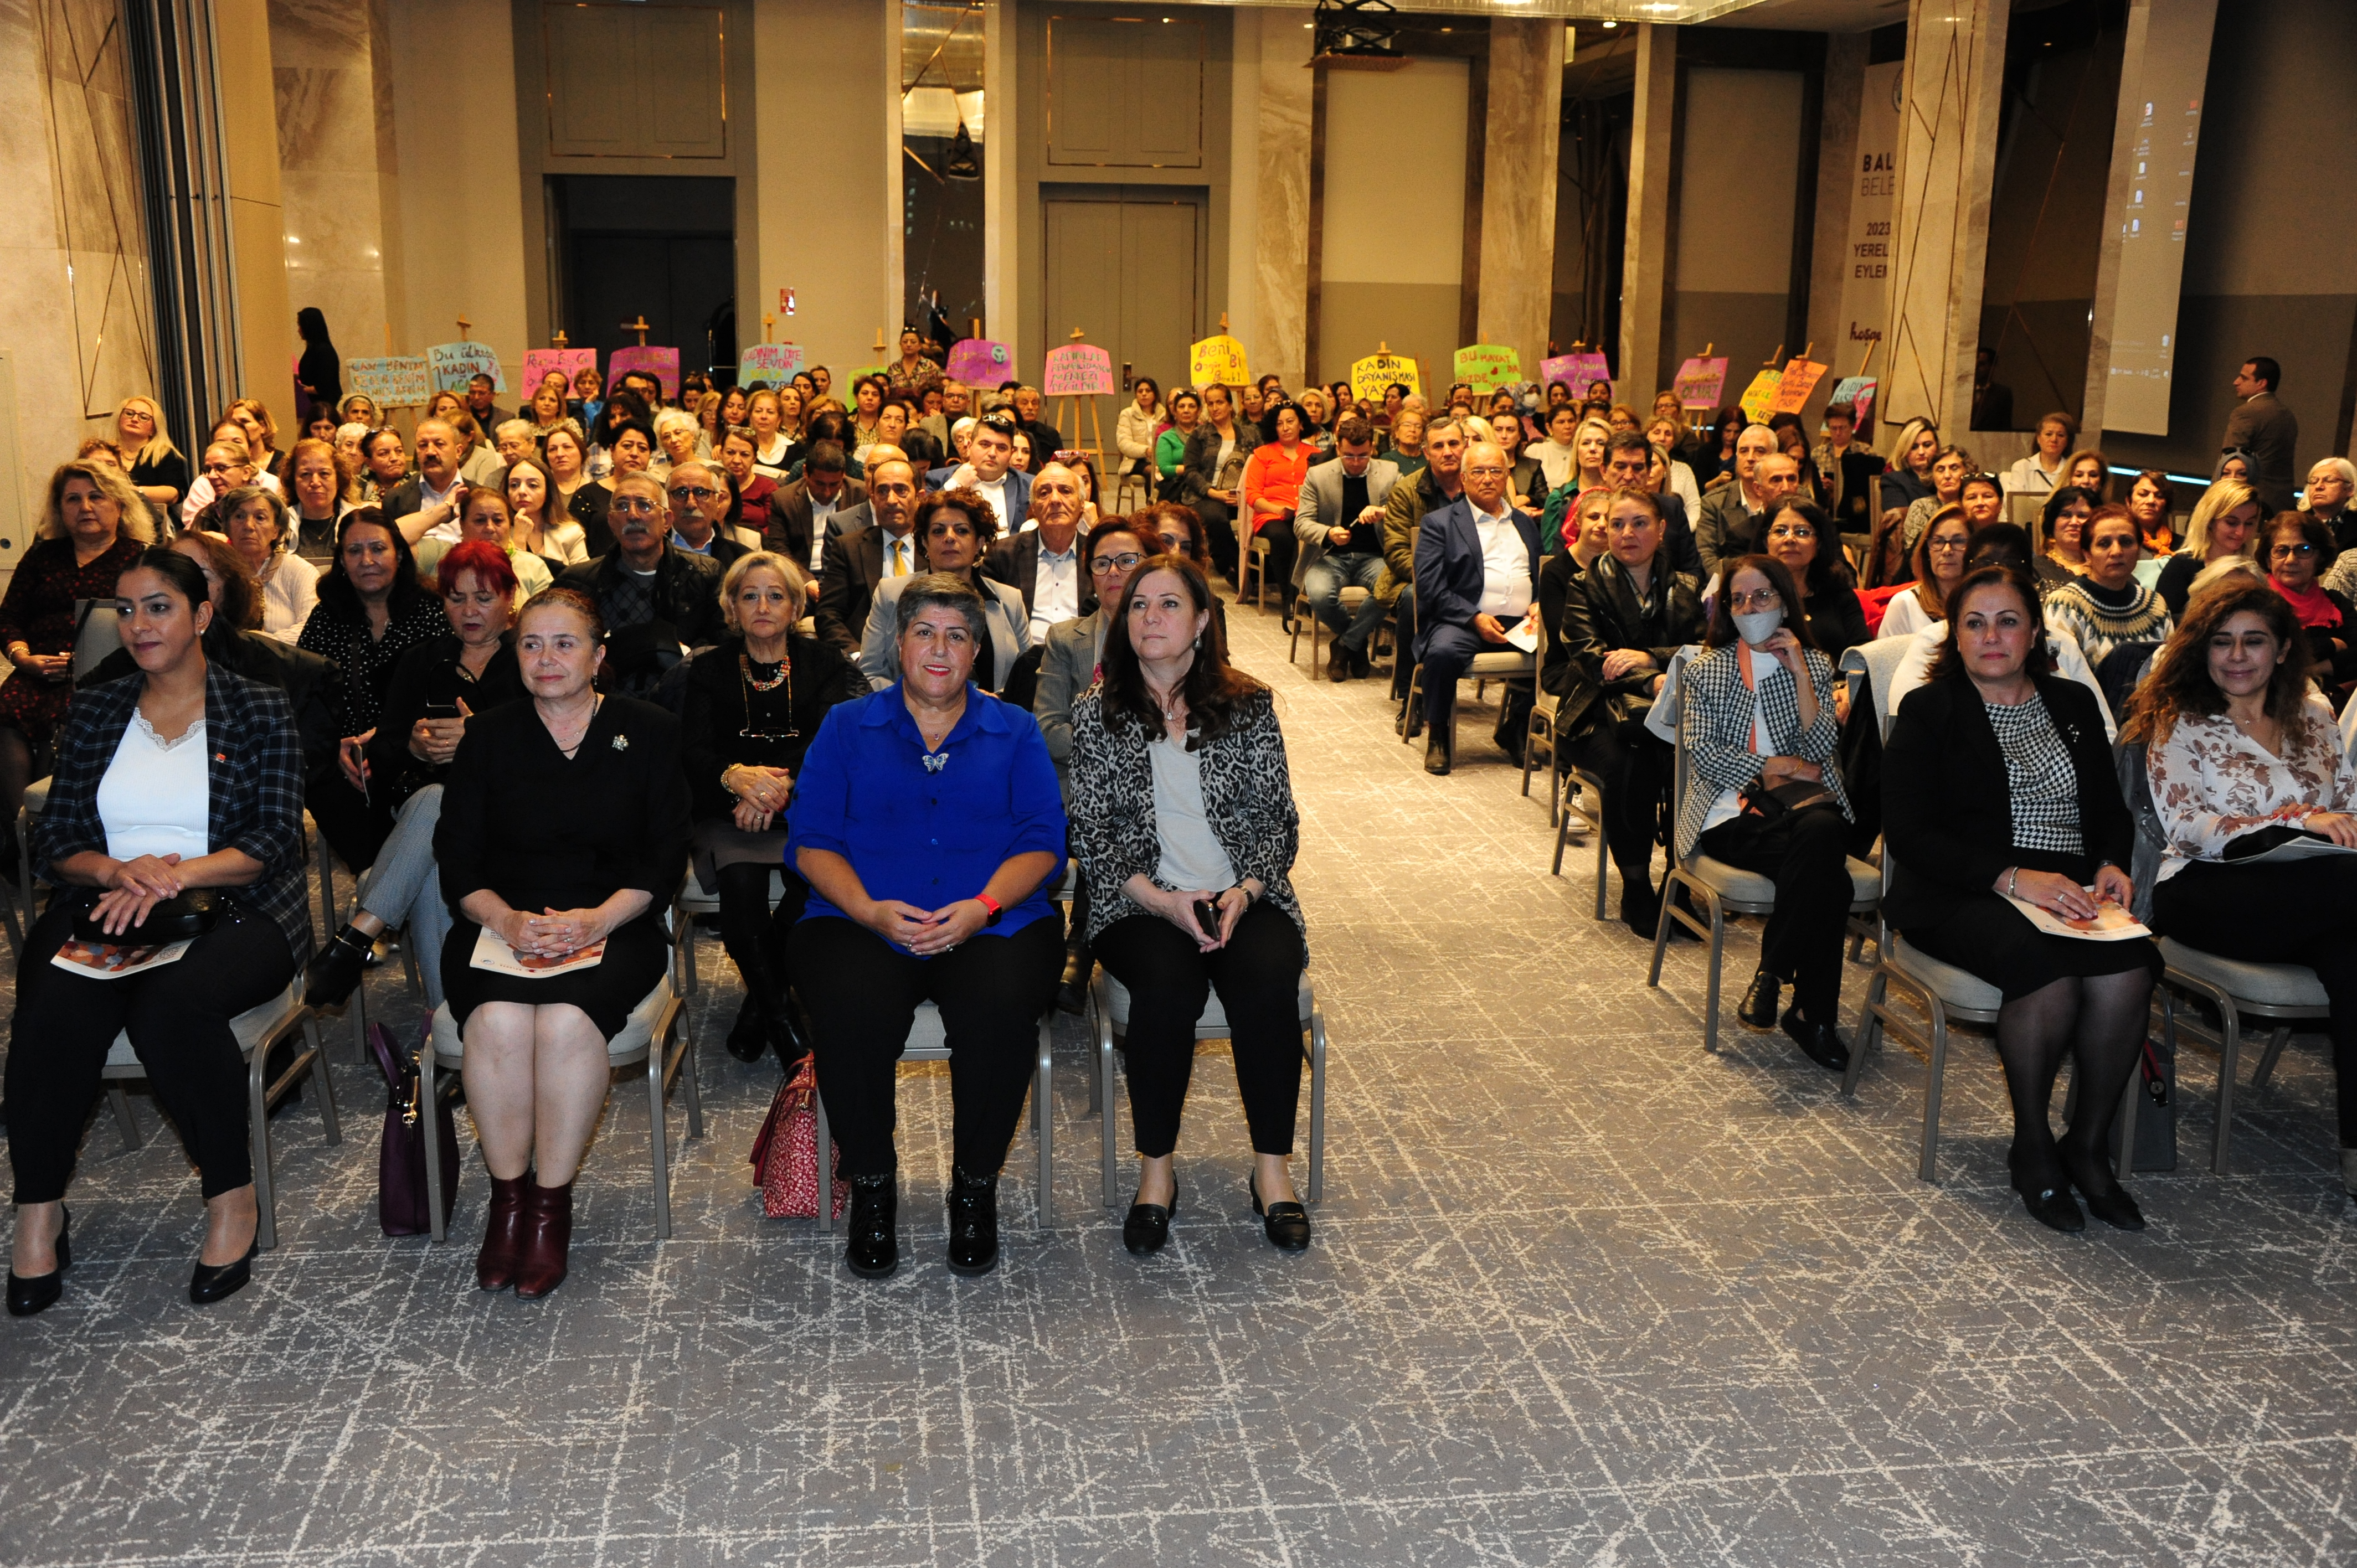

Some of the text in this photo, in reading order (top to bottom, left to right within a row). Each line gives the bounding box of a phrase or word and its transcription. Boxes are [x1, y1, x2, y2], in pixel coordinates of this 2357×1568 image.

[1862, 152, 1894, 172] BAL
[1866, 221, 1891, 236] 2023
[1854, 243, 1888, 257] YEREL
[434, 349, 454, 362] Bu
[1198, 341, 1230, 359] Beni
[1460, 350, 1478, 364] BU
[442, 362, 480, 375] KADIN
[1356, 358, 1401, 374] KADIN
